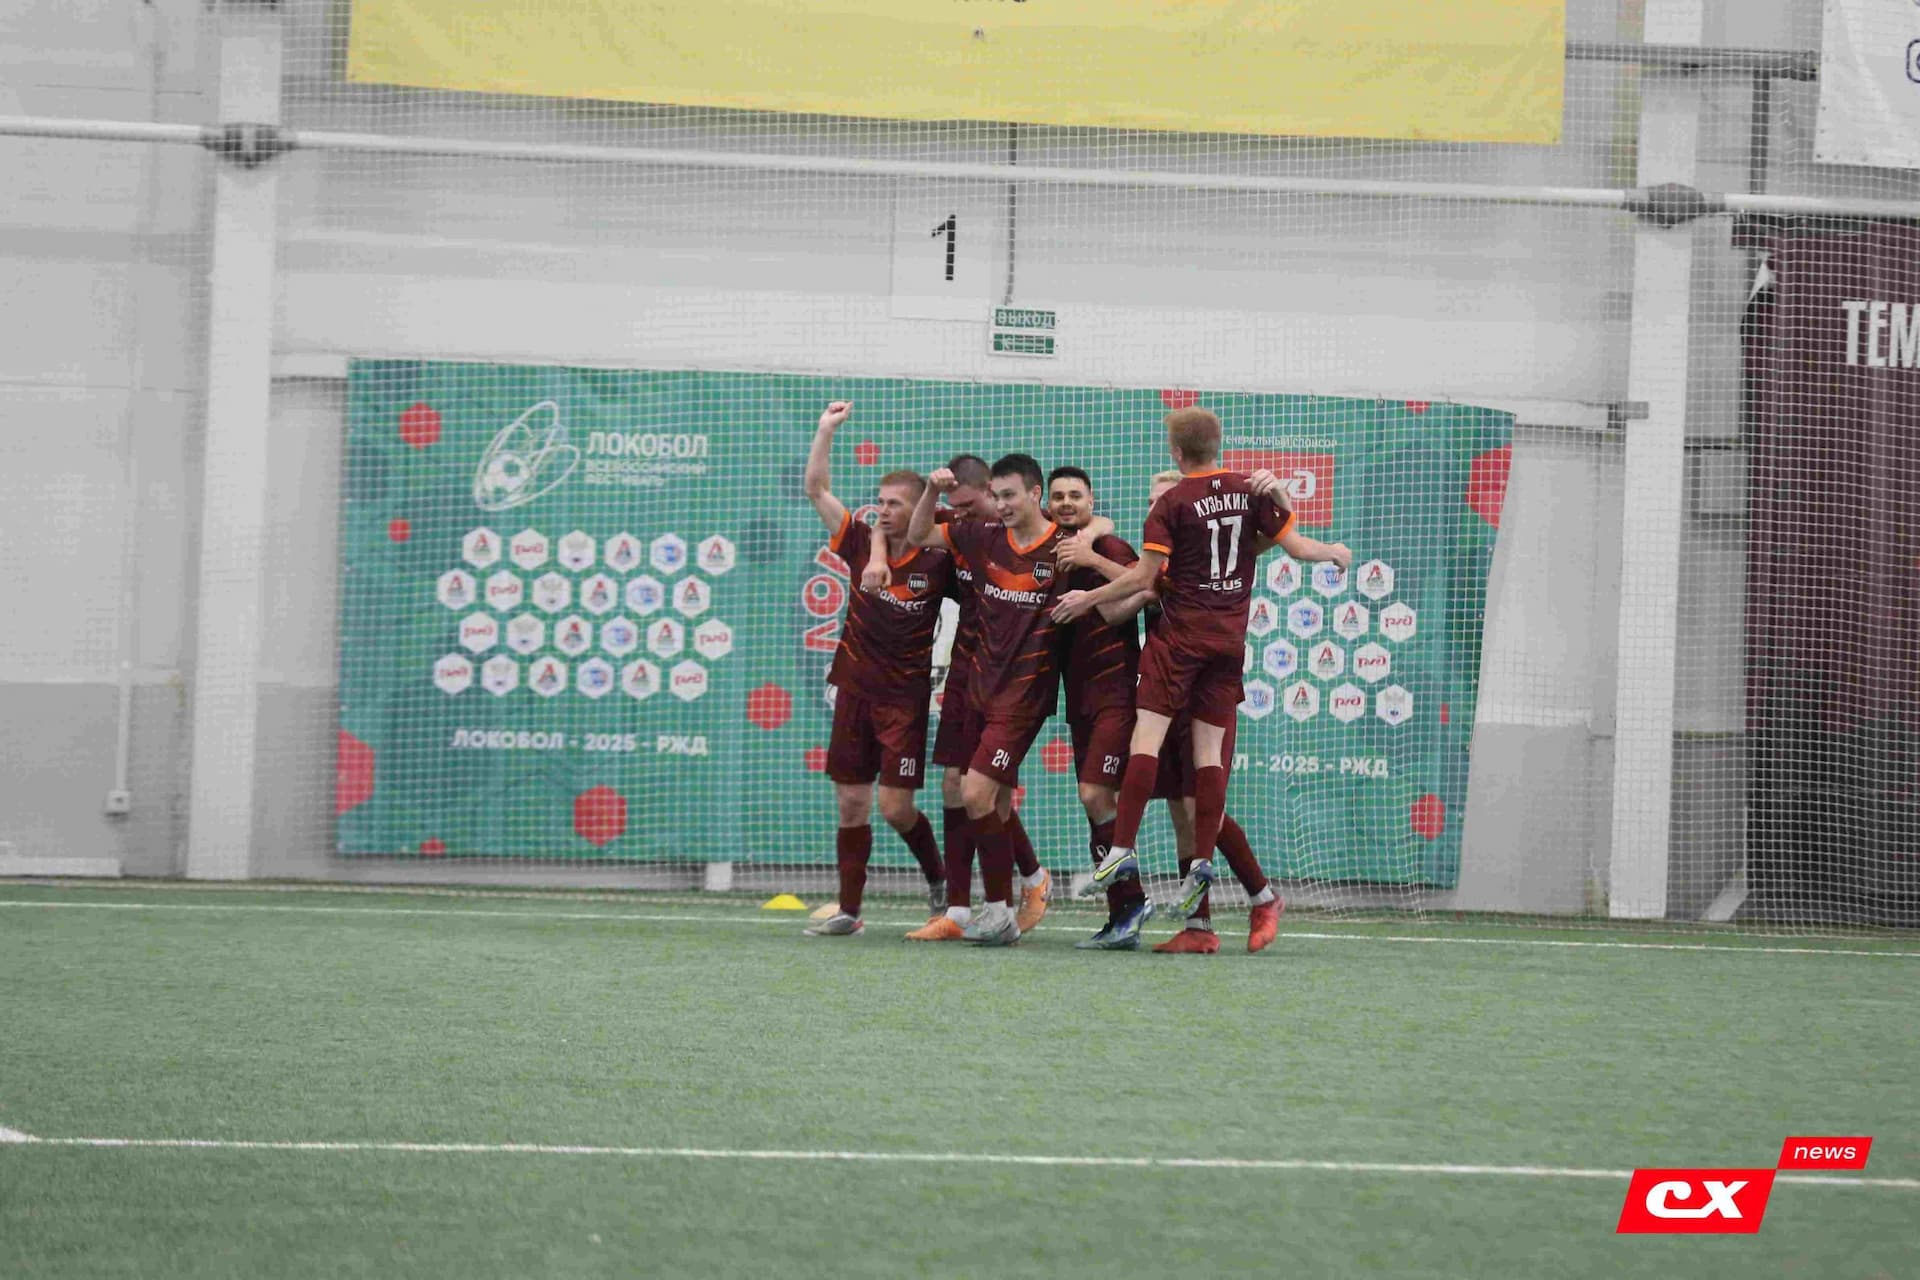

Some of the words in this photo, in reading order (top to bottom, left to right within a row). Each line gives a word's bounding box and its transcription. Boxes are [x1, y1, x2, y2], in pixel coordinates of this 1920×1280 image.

[931, 214, 956, 281] 1
[586, 431, 707, 457] ЛОКОБОЛ
[1193, 493, 1249, 518] КУЗЬКИН
[1206, 515, 1242, 579] 17
[452, 729, 563, 749] ЛОКОБОЛ
[583, 733, 636, 752] 2025
[656, 735, 709, 756] РЖД
[900, 758, 916, 776] 20
[992, 748, 1010, 771] 24
[1103, 755, 1119, 775] 23
[1269, 755, 1319, 772] 2025
[1340, 757, 1389, 778] РЖД
